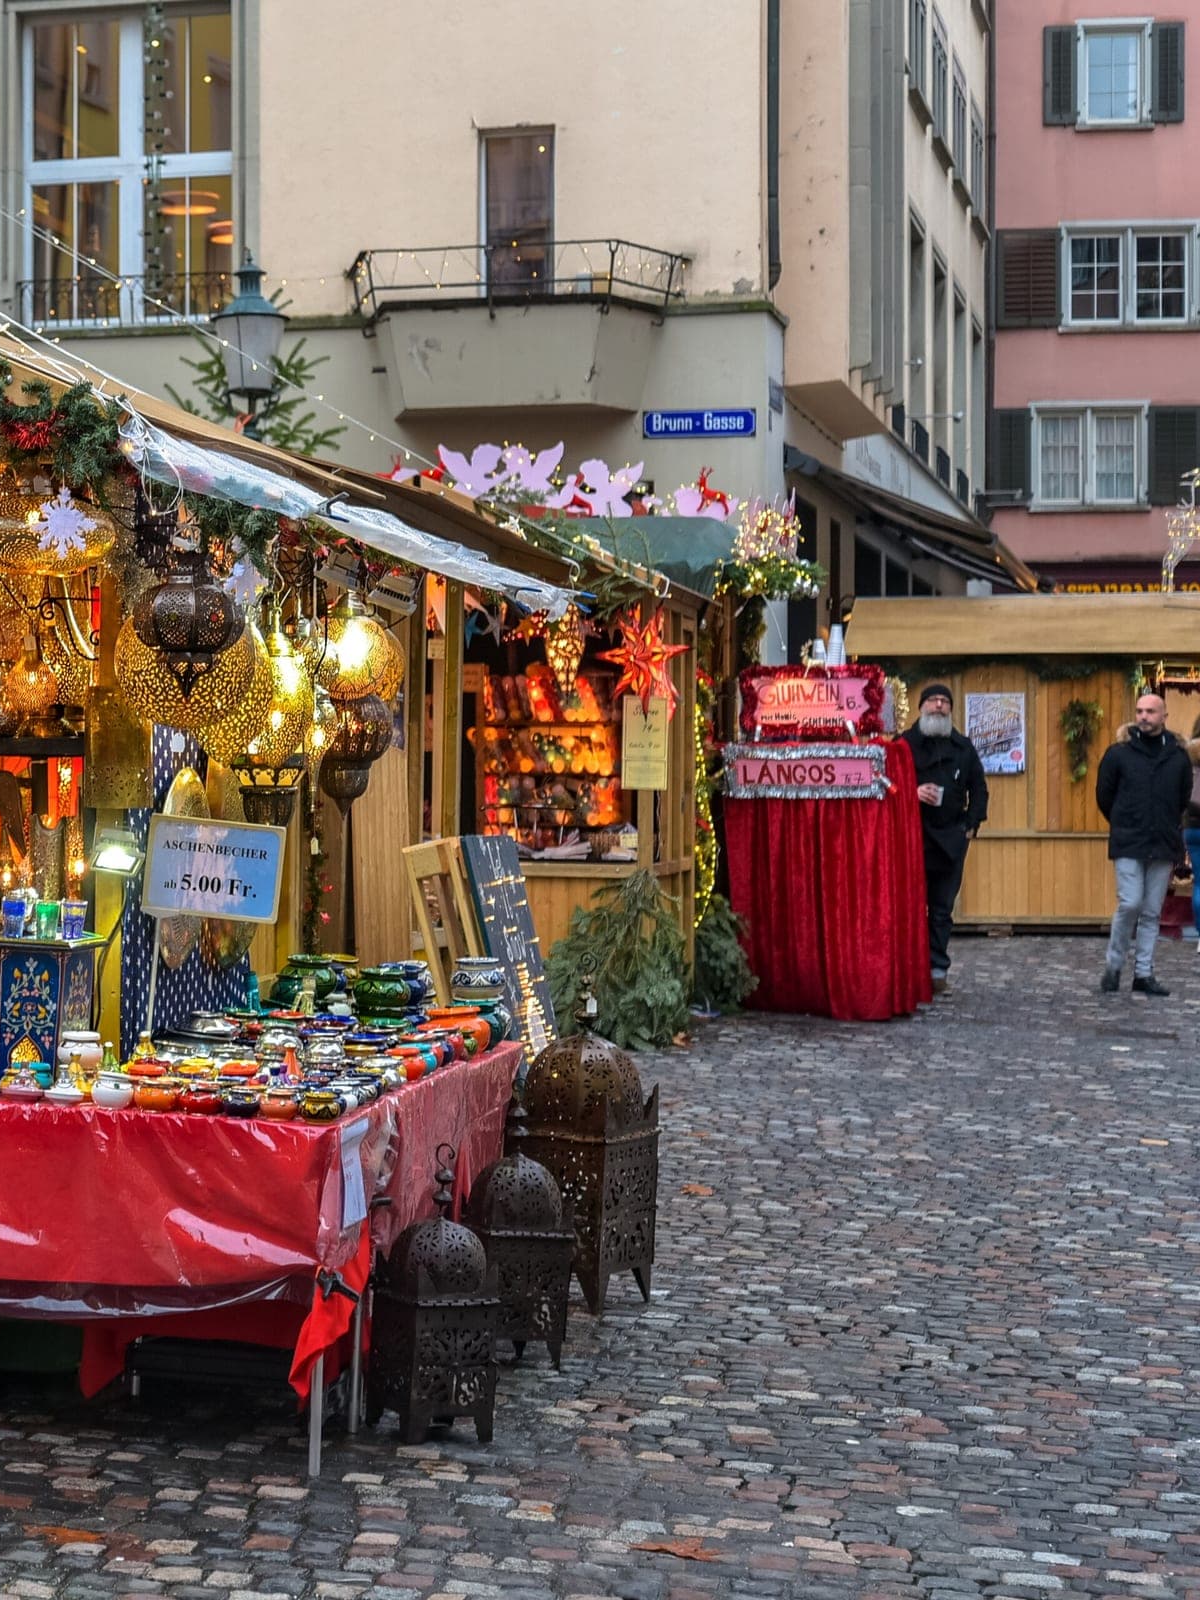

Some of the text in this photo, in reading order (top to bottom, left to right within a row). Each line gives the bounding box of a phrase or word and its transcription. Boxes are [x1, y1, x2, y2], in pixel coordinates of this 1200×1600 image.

[652, 411, 745, 432] Brunn Gasse
[162, 839, 268, 860] ASCHENBECHER
[163, 873, 257, 899] ab 5.00 Fr.
